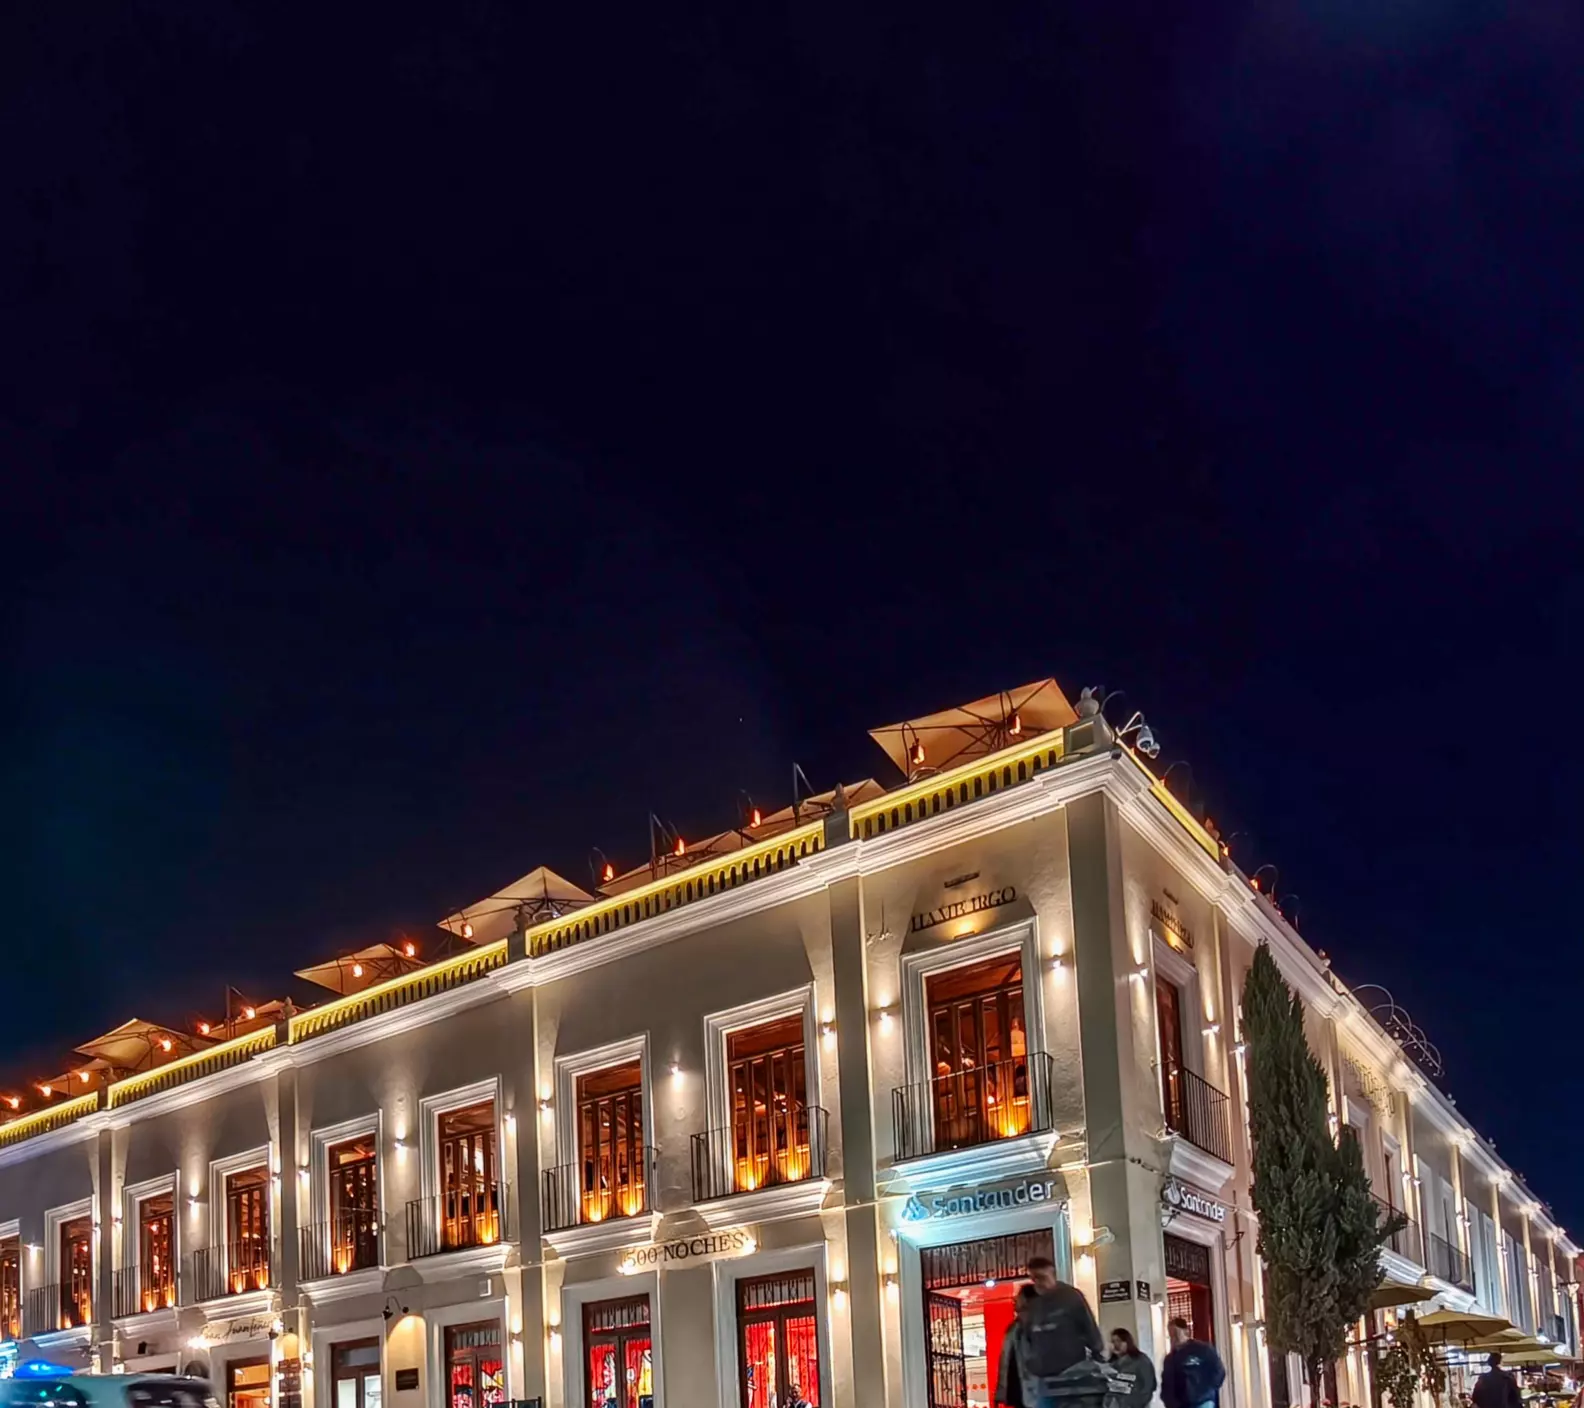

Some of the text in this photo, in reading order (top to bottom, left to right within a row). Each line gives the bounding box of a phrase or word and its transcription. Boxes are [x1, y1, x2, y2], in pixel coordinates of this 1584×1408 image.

[932, 1180, 1054, 1218] Santander
[625, 1232, 746, 1268] 500 NOCHES
